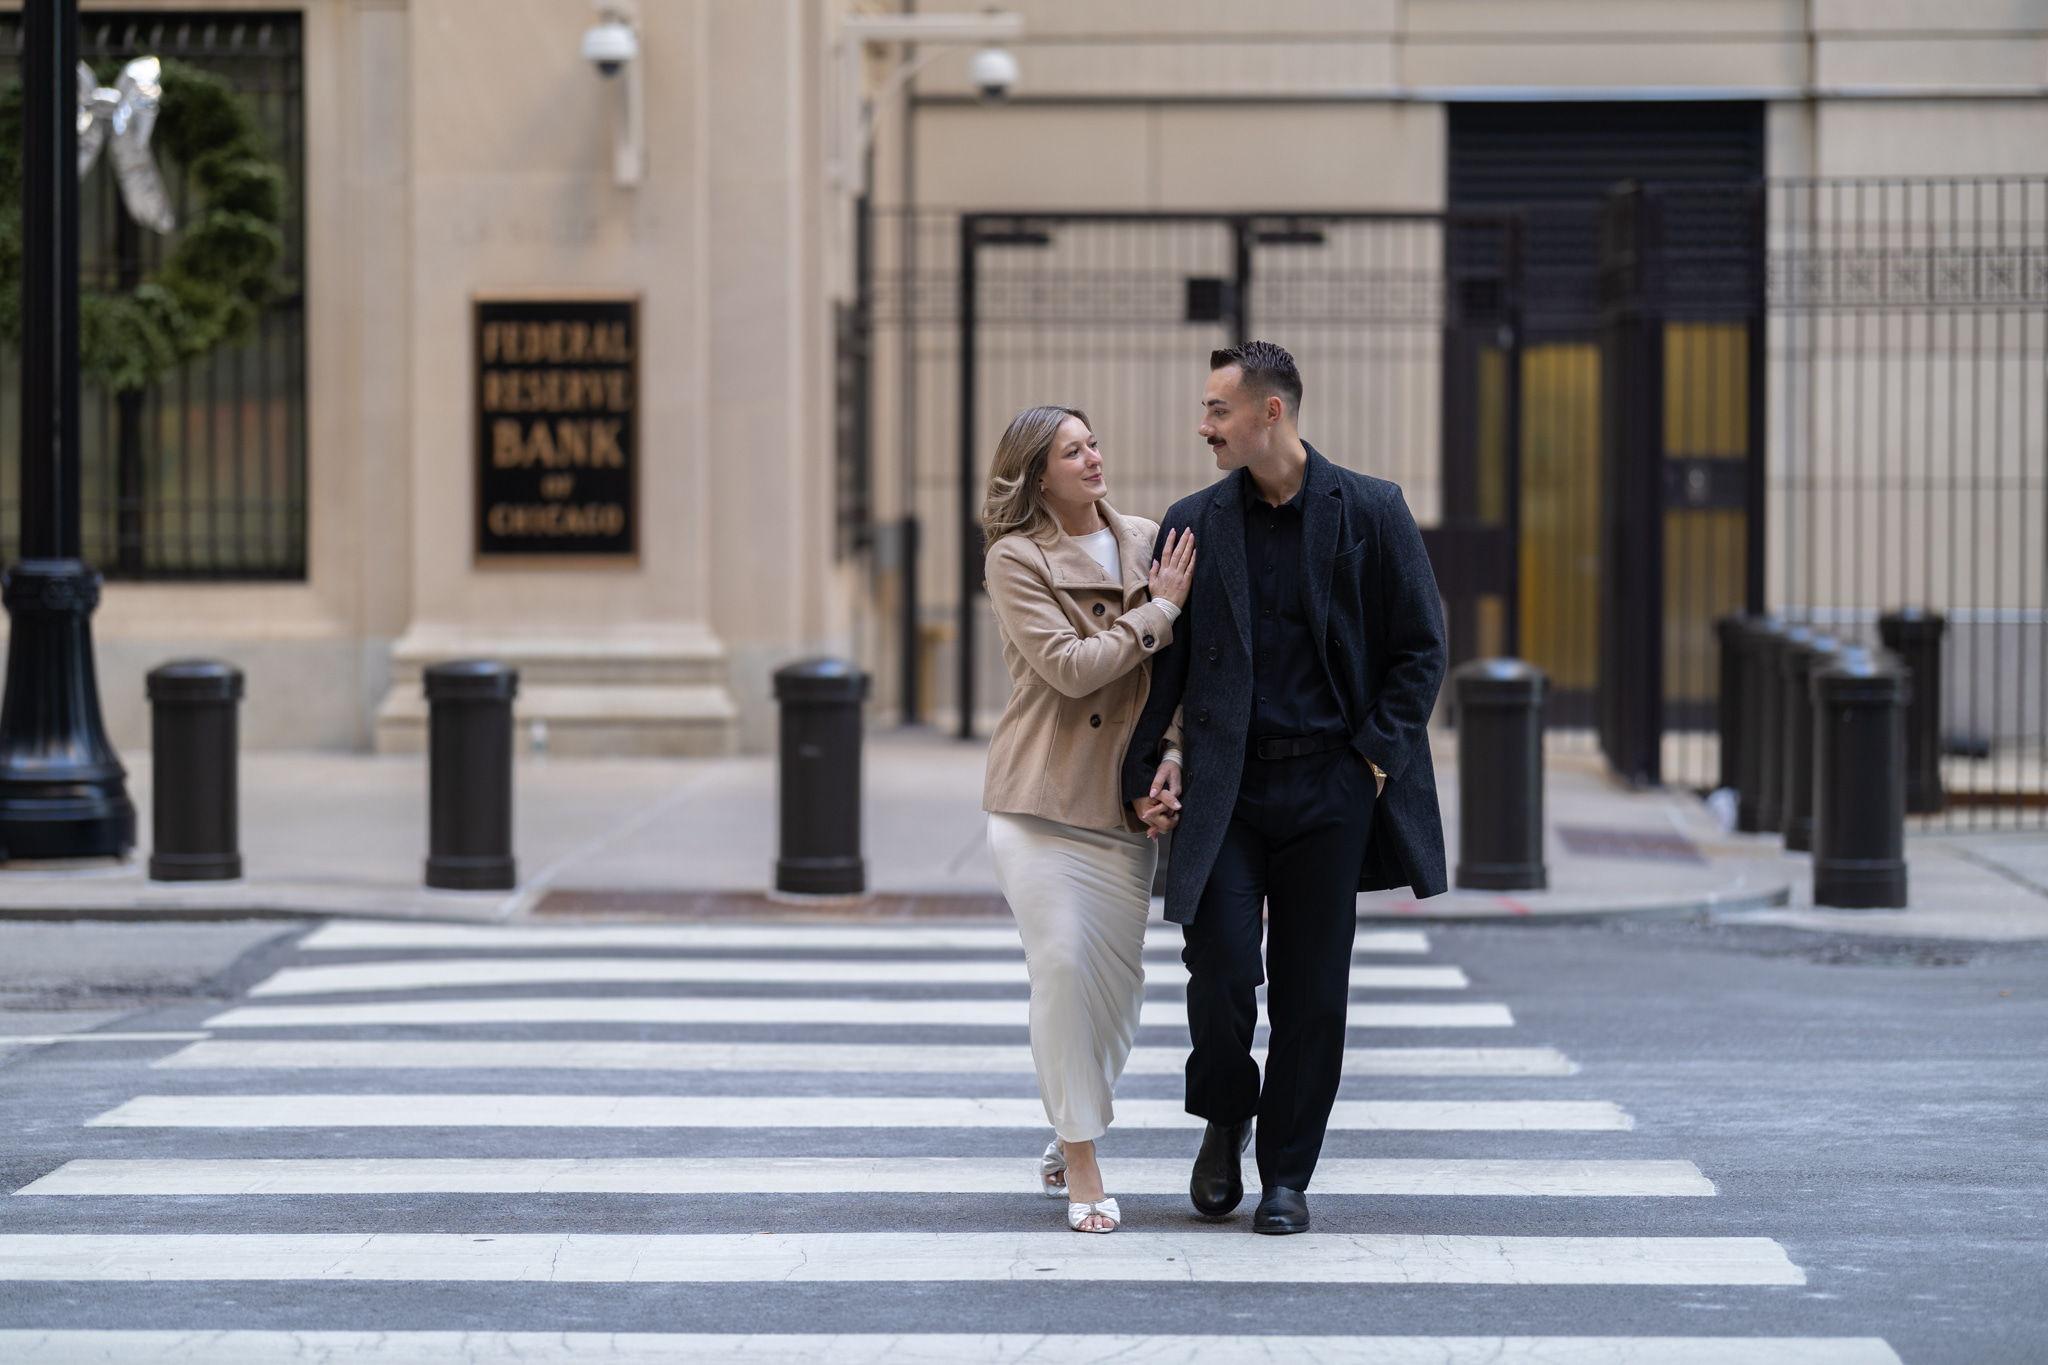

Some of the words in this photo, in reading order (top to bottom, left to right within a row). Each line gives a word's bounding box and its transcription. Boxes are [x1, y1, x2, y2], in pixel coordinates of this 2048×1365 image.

[483, 323, 634, 360] FEDERAL
[484, 372, 634, 409] RESERVE
[493, 420, 624, 465] BANK
[487, 505, 626, 533] CHICAGO
